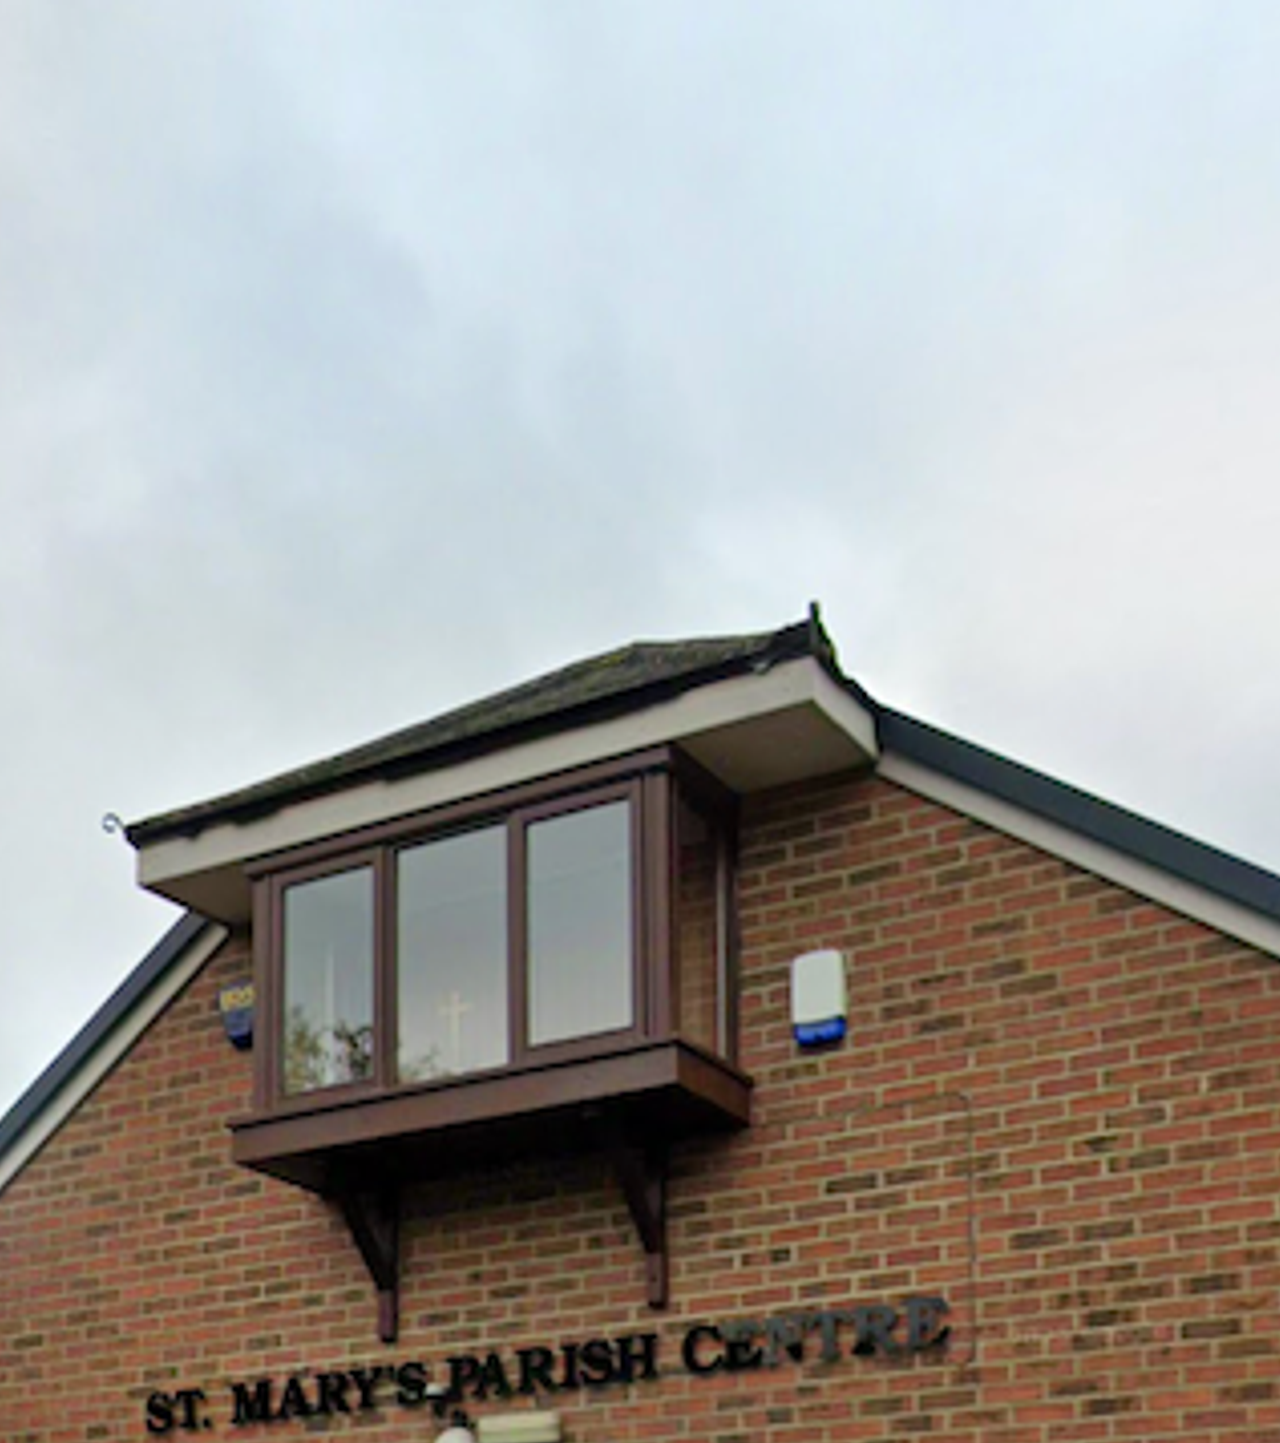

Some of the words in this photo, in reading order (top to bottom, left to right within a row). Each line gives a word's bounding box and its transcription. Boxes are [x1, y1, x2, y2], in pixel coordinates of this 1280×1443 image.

[146, 1388, 212, 1433] ST.
[230, 1360, 428, 1427] MARY'S
[446, 1334, 658, 1399] PARISH
[682, 1296, 952, 1373] CENTRE
